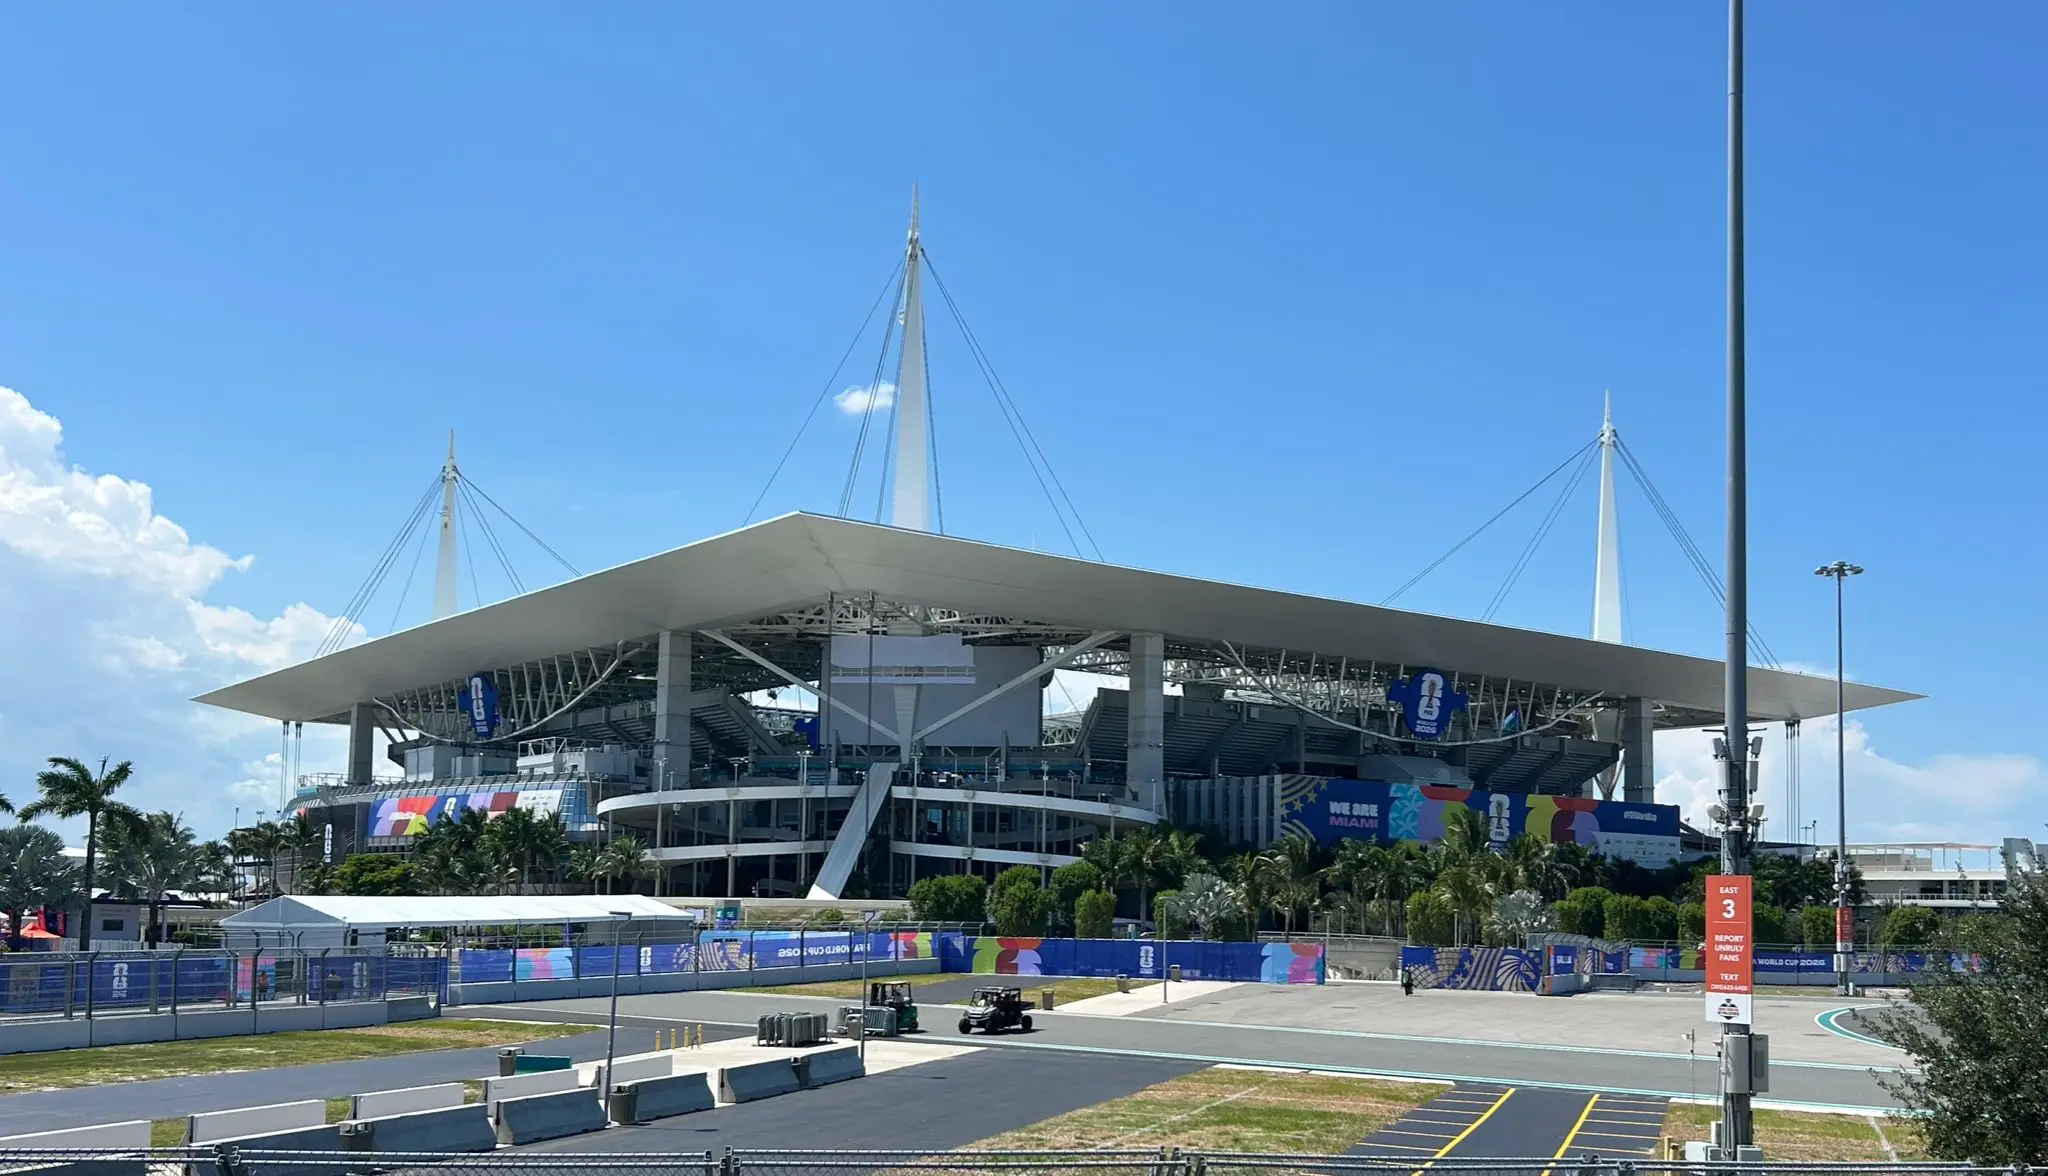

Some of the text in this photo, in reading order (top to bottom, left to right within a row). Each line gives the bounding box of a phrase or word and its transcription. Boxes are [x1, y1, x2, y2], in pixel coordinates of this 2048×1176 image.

[1330, 801, 1378, 816] WE ARE
[1330, 816, 1378, 828] MIAMI
[1719, 886, 1739, 894] EAST
[1722, 898, 1735, 919] 3
[1714, 934, 1744, 942] REPORT
[1715, 944, 1744, 952] UNRULY
[1719, 953, 1740, 962] FANS
